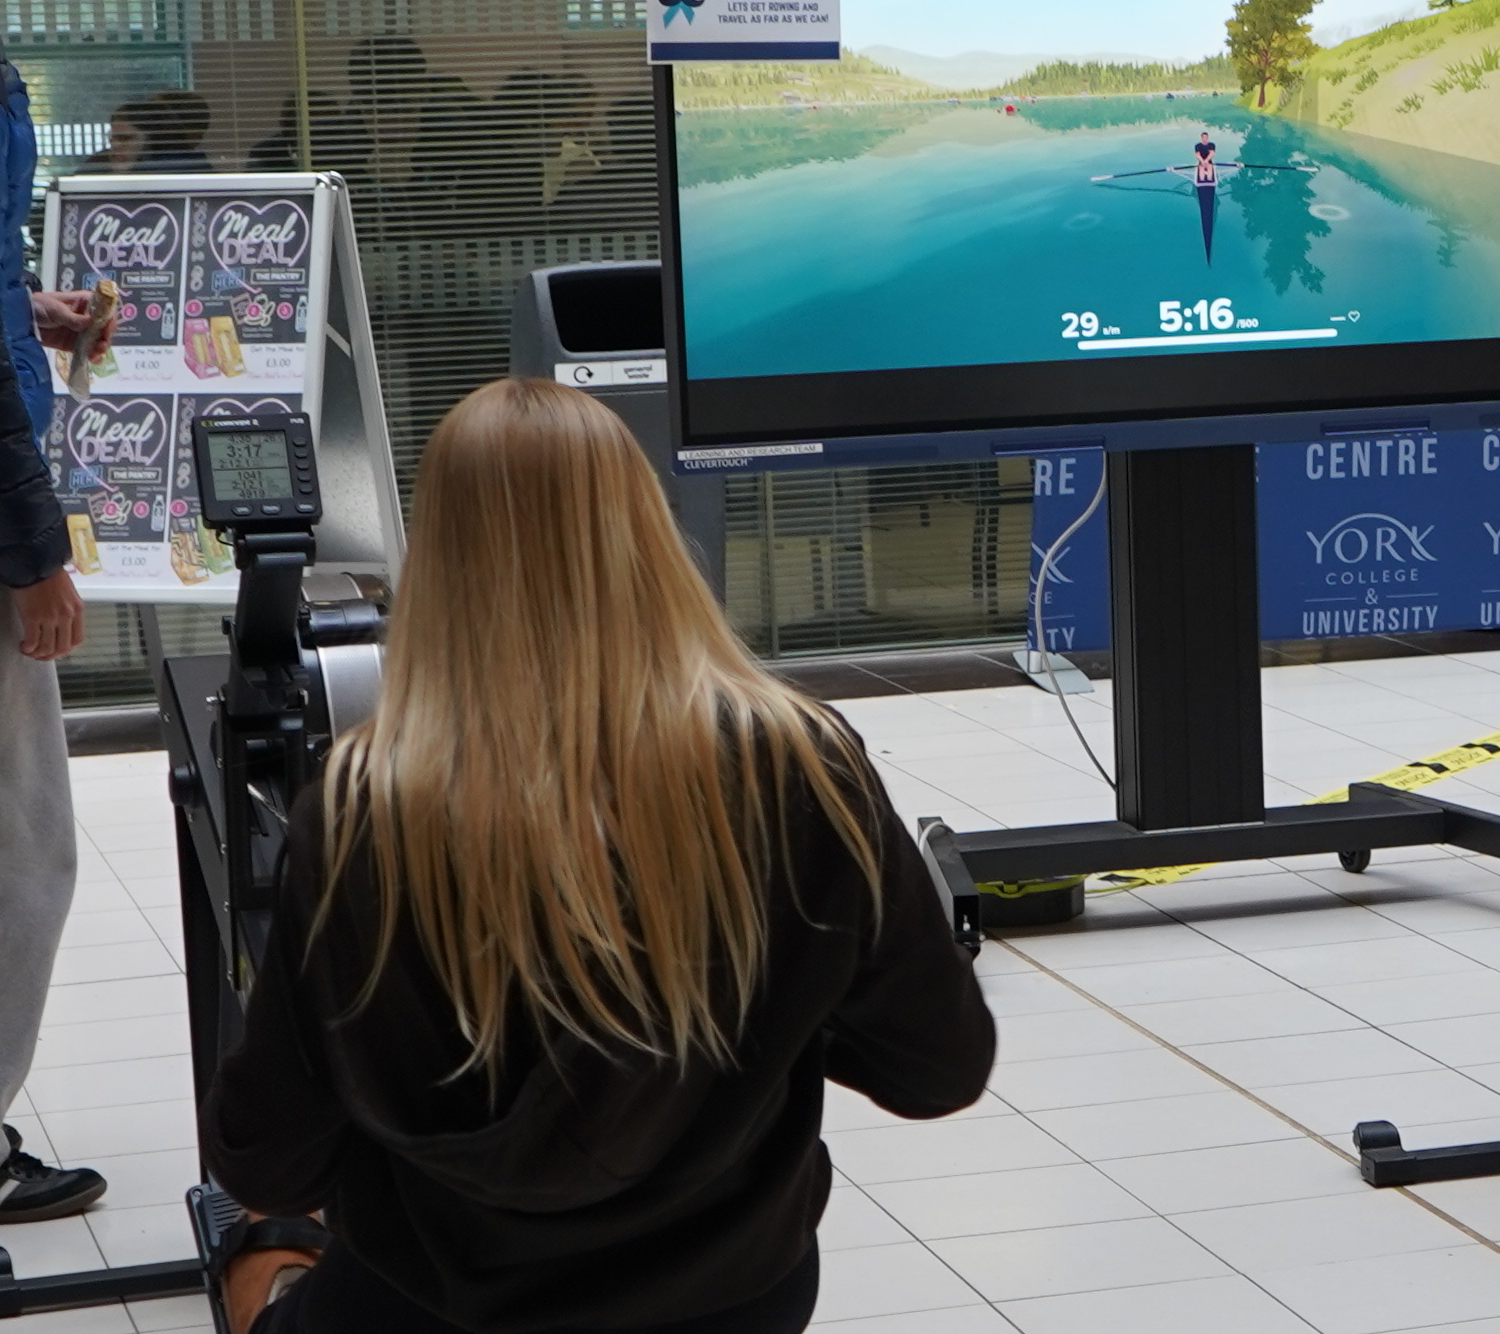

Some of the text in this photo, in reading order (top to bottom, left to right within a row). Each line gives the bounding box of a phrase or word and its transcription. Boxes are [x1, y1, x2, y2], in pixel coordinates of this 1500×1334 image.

[718, 14, 829, 24] TRAVEL AS FAR AS WE CAN!
[728, 2, 819, 12] LETS GET ROWING AND
[88, 212, 169, 246] Meal
[217, 209, 298, 244] Meal
[93, 241, 163, 268] DEAL
[222, 238, 293, 265] DEAL
[1061, 312, 1099, 339] 29
[1159, 297, 1259, 333] 5:16 /500
[135, 360, 160, 370] £4.00
[266, 358, 291, 367] £3.00
[76, 407, 156, 441] Meal
[80, 436, 151, 464] DEAL
[227, 445, 262, 458] 3:17
[685, 444, 816, 459] LEARNING AND RESEARCH TEAM
[1306, 438, 1438, 480] CENTRE
[1305, 513, 1438, 565] YORK
[121, 556, 146, 566] £3.00
[1325, 568, 1419, 586] COLLEGE
[1364, 588, 1379, 605] &
[1302, 605, 1438, 636] UNIVERSITY
